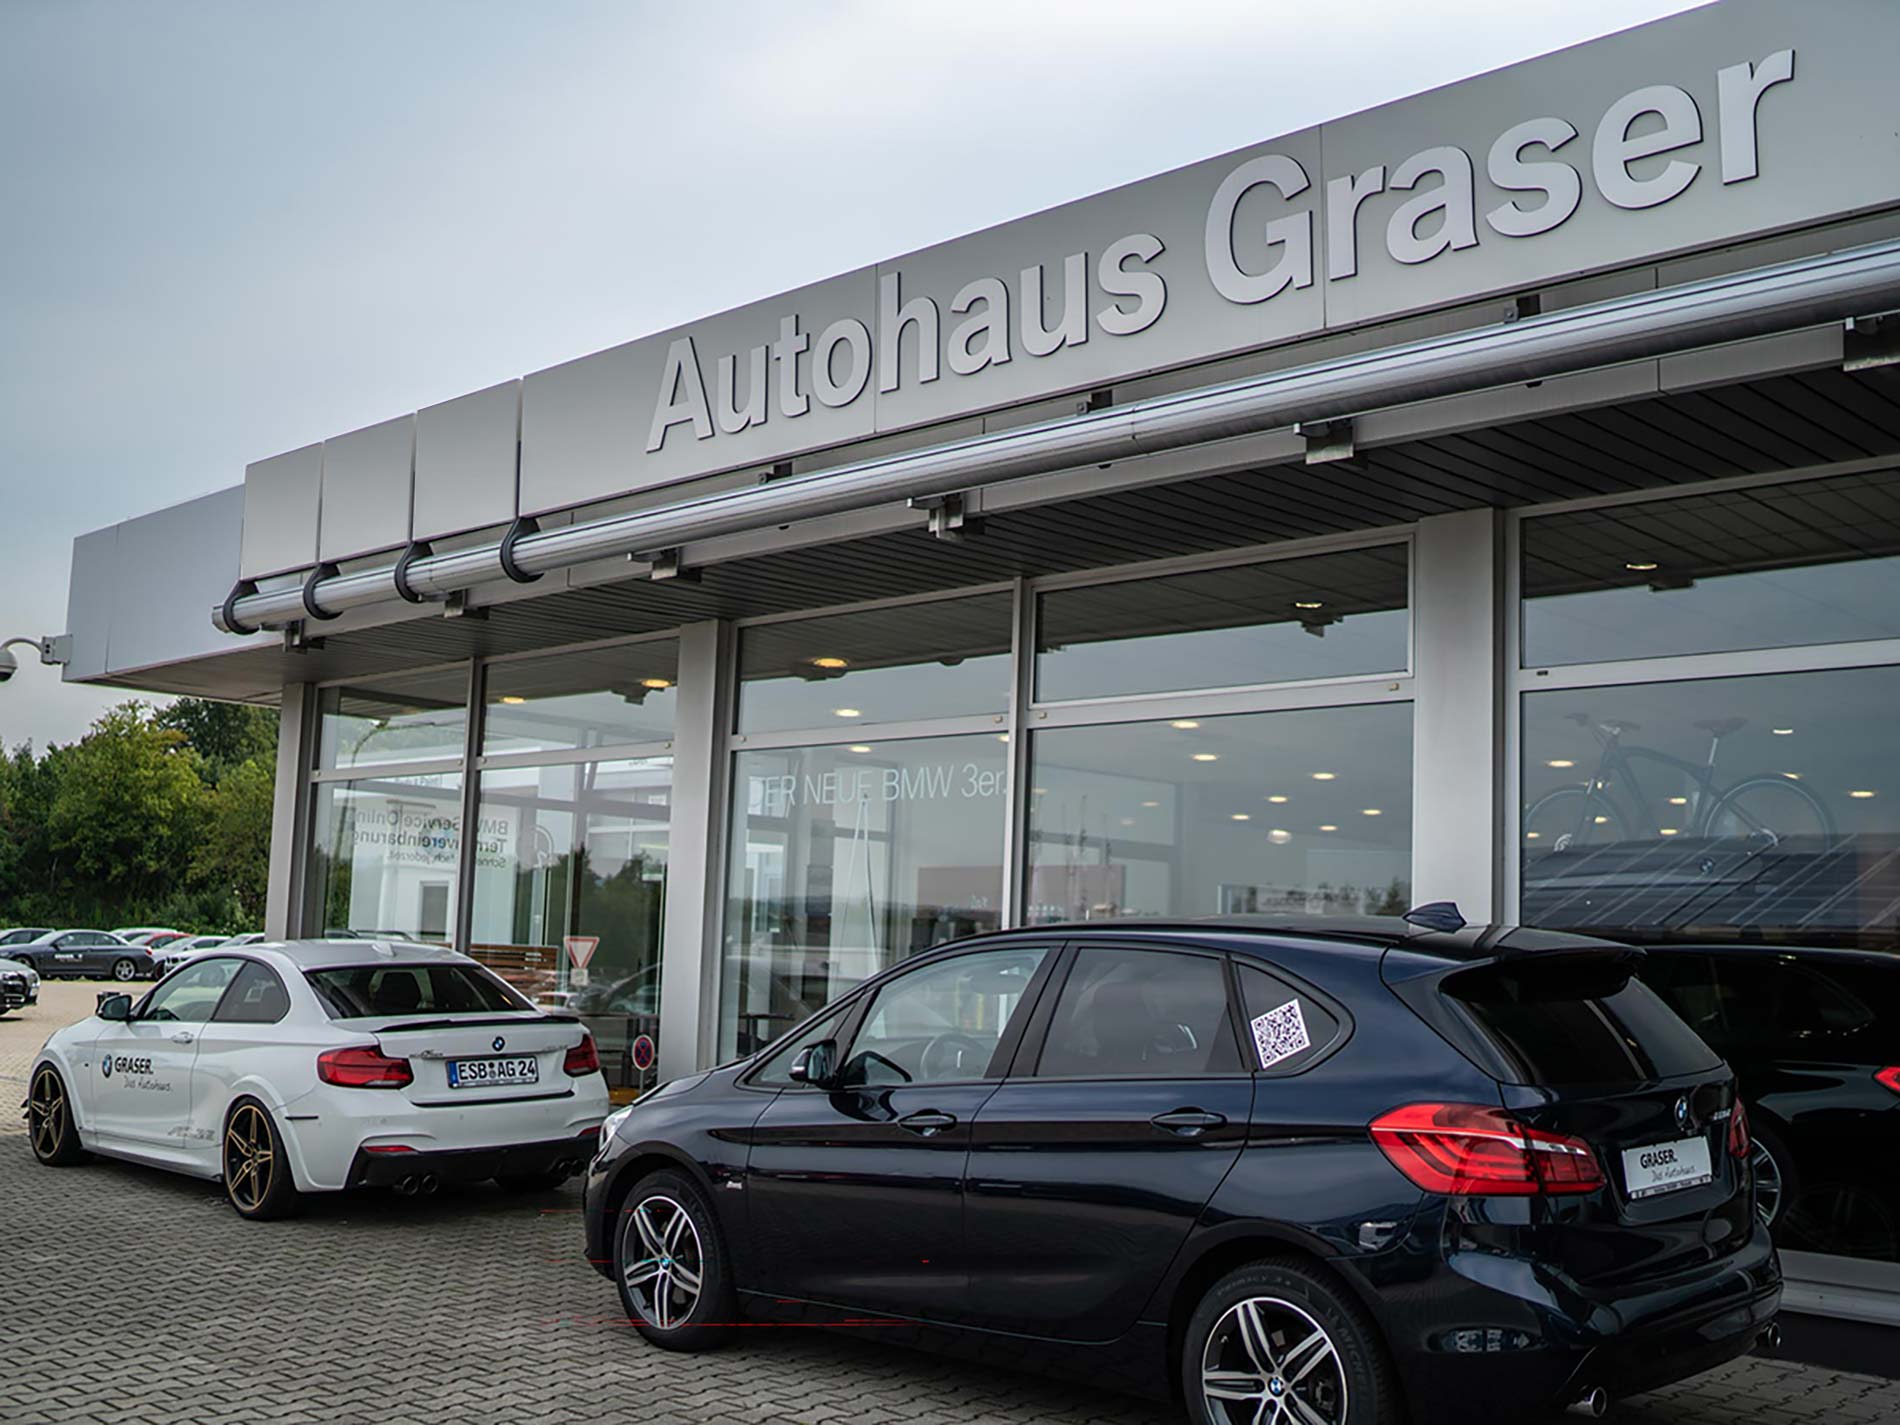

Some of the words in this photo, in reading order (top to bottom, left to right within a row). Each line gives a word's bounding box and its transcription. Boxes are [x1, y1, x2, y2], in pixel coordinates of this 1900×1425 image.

[646, 233, 1168, 453] Autohaus
[1204, 48, 1796, 305] Graser
[803, 769, 873, 805] NEUE
[882, 765, 954, 801] BMW
[115, 1056, 154, 1075] GRASER.
[458, 1061, 488, 1081] ESB
[497, 1061, 515, 1078] AG
[519, 1060, 536, 1077] 24
[1640, 1148, 1678, 1169] GRASER.
